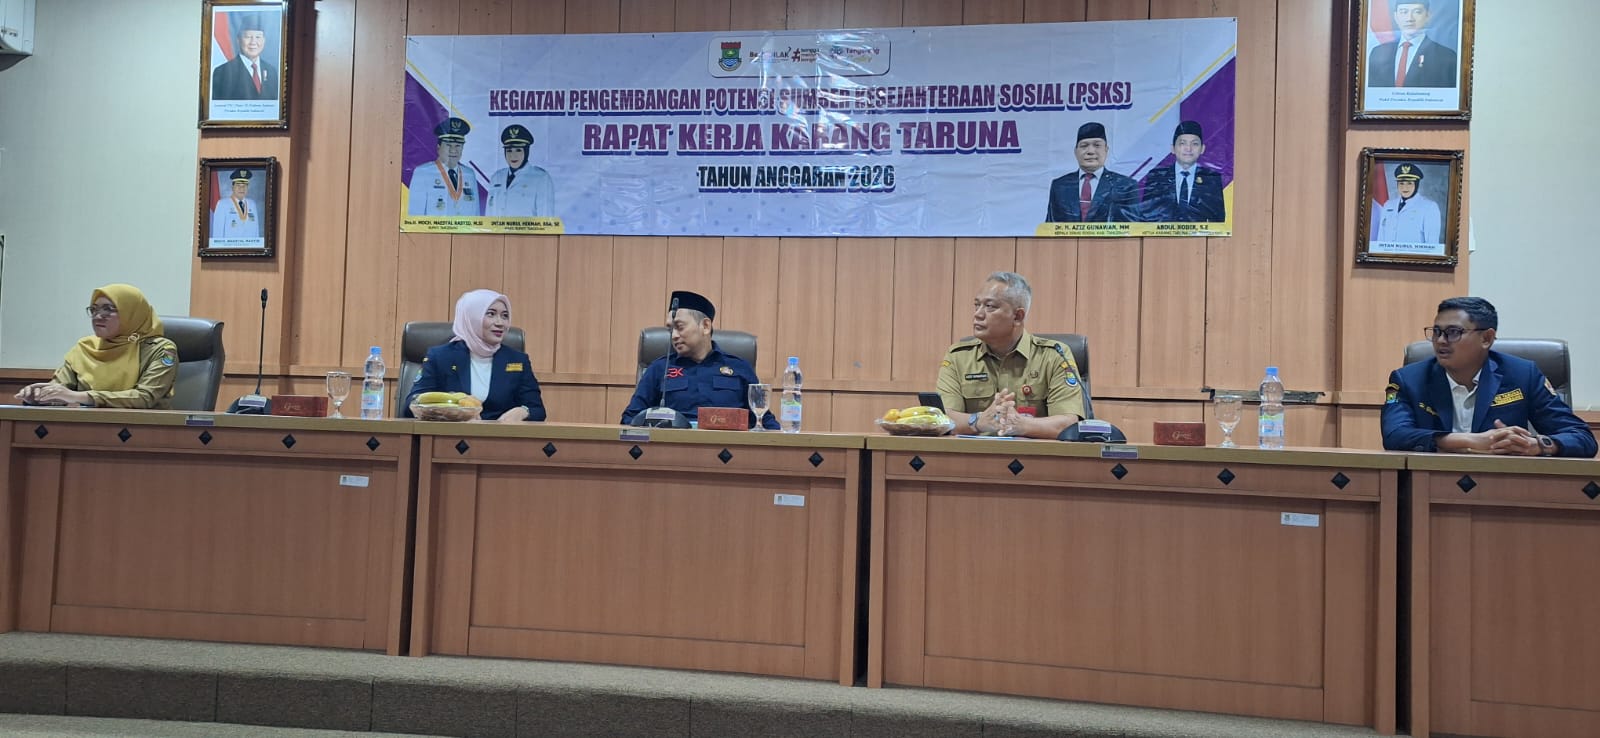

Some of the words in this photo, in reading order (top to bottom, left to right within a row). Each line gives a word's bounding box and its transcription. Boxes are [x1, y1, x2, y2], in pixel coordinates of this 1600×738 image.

[489, 90, 565, 112] KEGIATAN
[569, 89, 701, 111] PENGEMBANGAN
[705, 88, 775, 111] POTENSI
[779, 87, 850, 109] SUMBER
[854, 85, 996, 108] KESEJAHTERAAN
[999, 83, 1064, 106] SOSIAL
[1068, 82, 1132, 106] (PSKS)
[583, 123, 672, 151] RAPAT
[678, 123, 764, 151] KERJA
[771, 122, 891, 151] KARANG
[899, 120, 1020, 149] TARUNA
[697, 166, 752, 188] TAHUN
[755, 165, 846, 188] ANGGARAN
[848, 164, 895, 188] 2026
